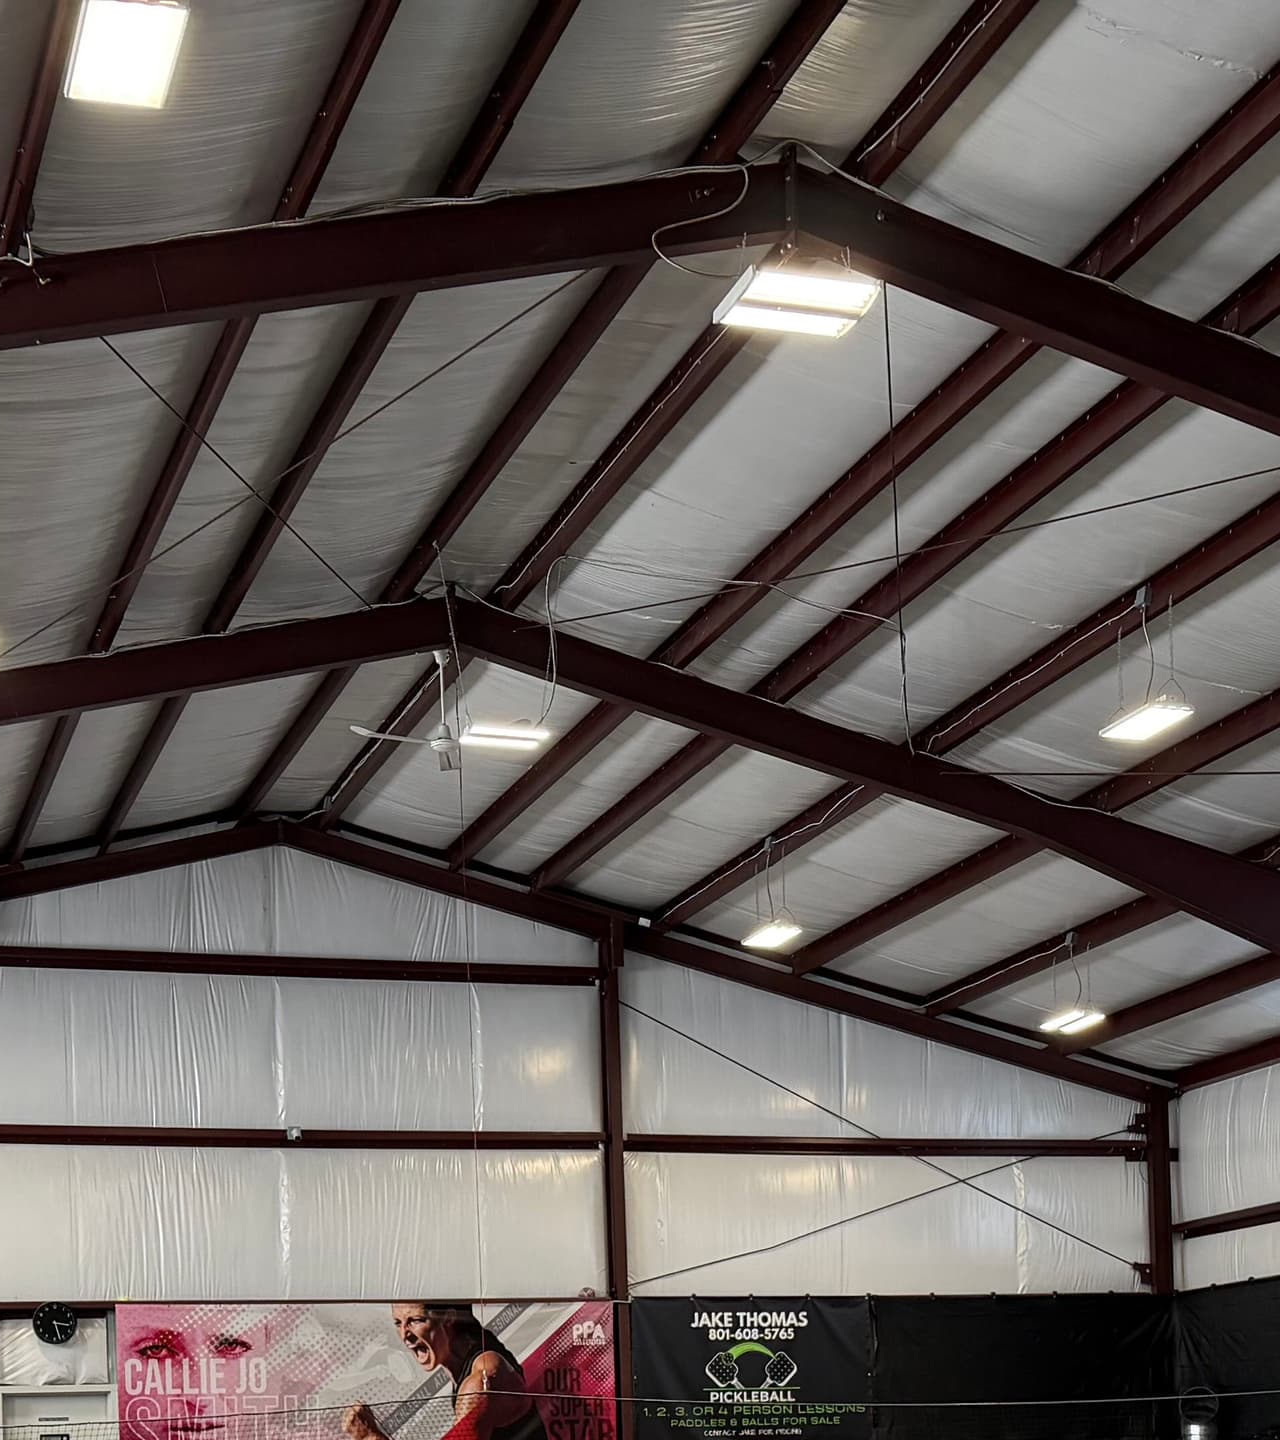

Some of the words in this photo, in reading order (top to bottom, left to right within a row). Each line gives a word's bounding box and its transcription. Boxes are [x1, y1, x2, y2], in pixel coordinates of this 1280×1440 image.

[690, 1312, 733, 1328] JAKE
[736, 1311, 809, 1328] THOMAS
[572, 1321, 606, 1341] PPA
[708, 1328, 795, 1341] 801-608-5765
[124, 1358, 226, 1396] CALLIE
[235, 1358, 269, 1395] JO
[544, 1367, 581, 1393] OUR
[709, 1390, 796, 1403] PICKLEBALL
[550, 1398, 604, 1417] SUPER
[692, 1406, 714, 1416] OR
[718, 1405, 728, 1415] 4
[733, 1404, 793, 1415] PERSON
[798, 1403, 866, 1414] LESSONS
[670, 1418, 726, 1428] PADDLES
[741, 1417, 779, 1426] BALLS
[783, 1416, 807, 1426] FOR
[810, 1416, 841, 1425] SALE
